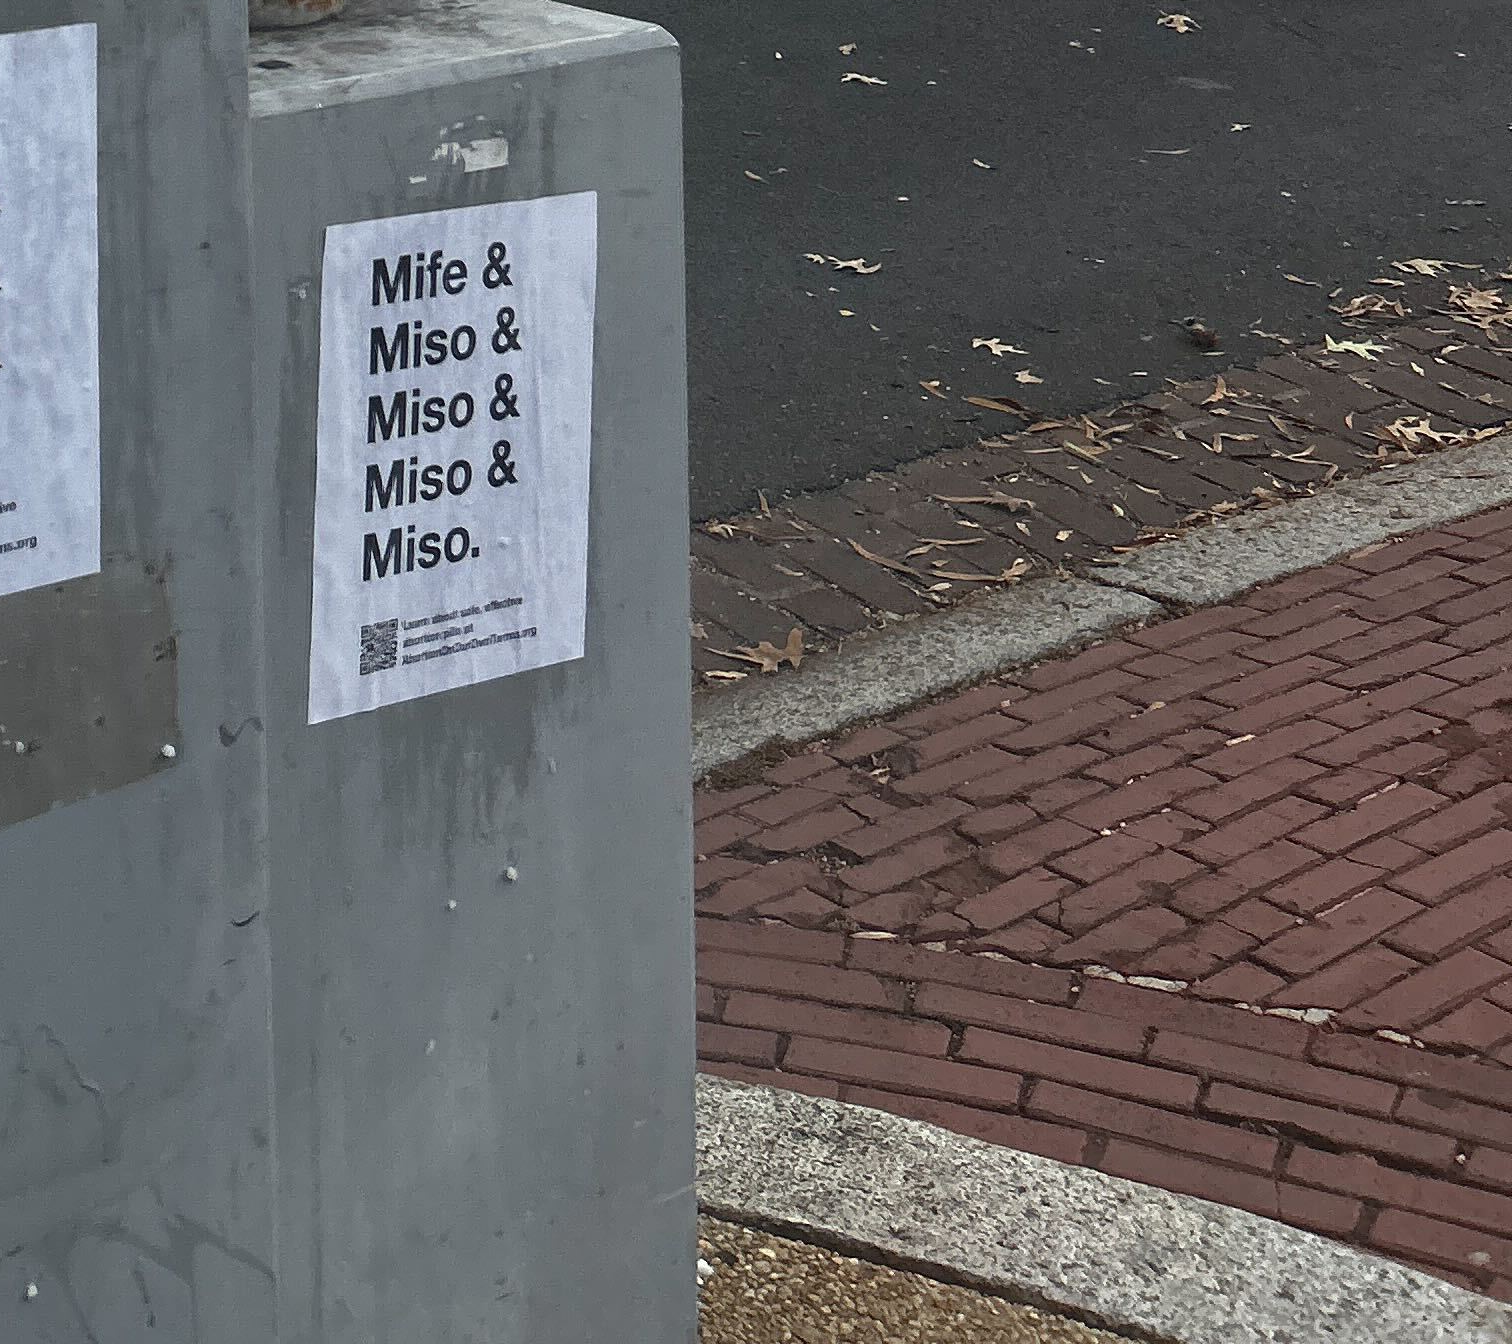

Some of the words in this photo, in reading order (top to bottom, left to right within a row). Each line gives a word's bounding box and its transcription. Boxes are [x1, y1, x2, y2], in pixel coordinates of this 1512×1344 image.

[371, 249, 468, 307] Mife
[482, 241, 514, 290] &
[369, 319, 477, 376] Miso
[491, 306, 523, 355] &
[367, 387, 475, 444] Miso
[489, 372, 521, 422] &
[364, 455, 473, 513] Miso
[487, 439, 519, 488] &
[362, 524, 480, 582] Miso.
